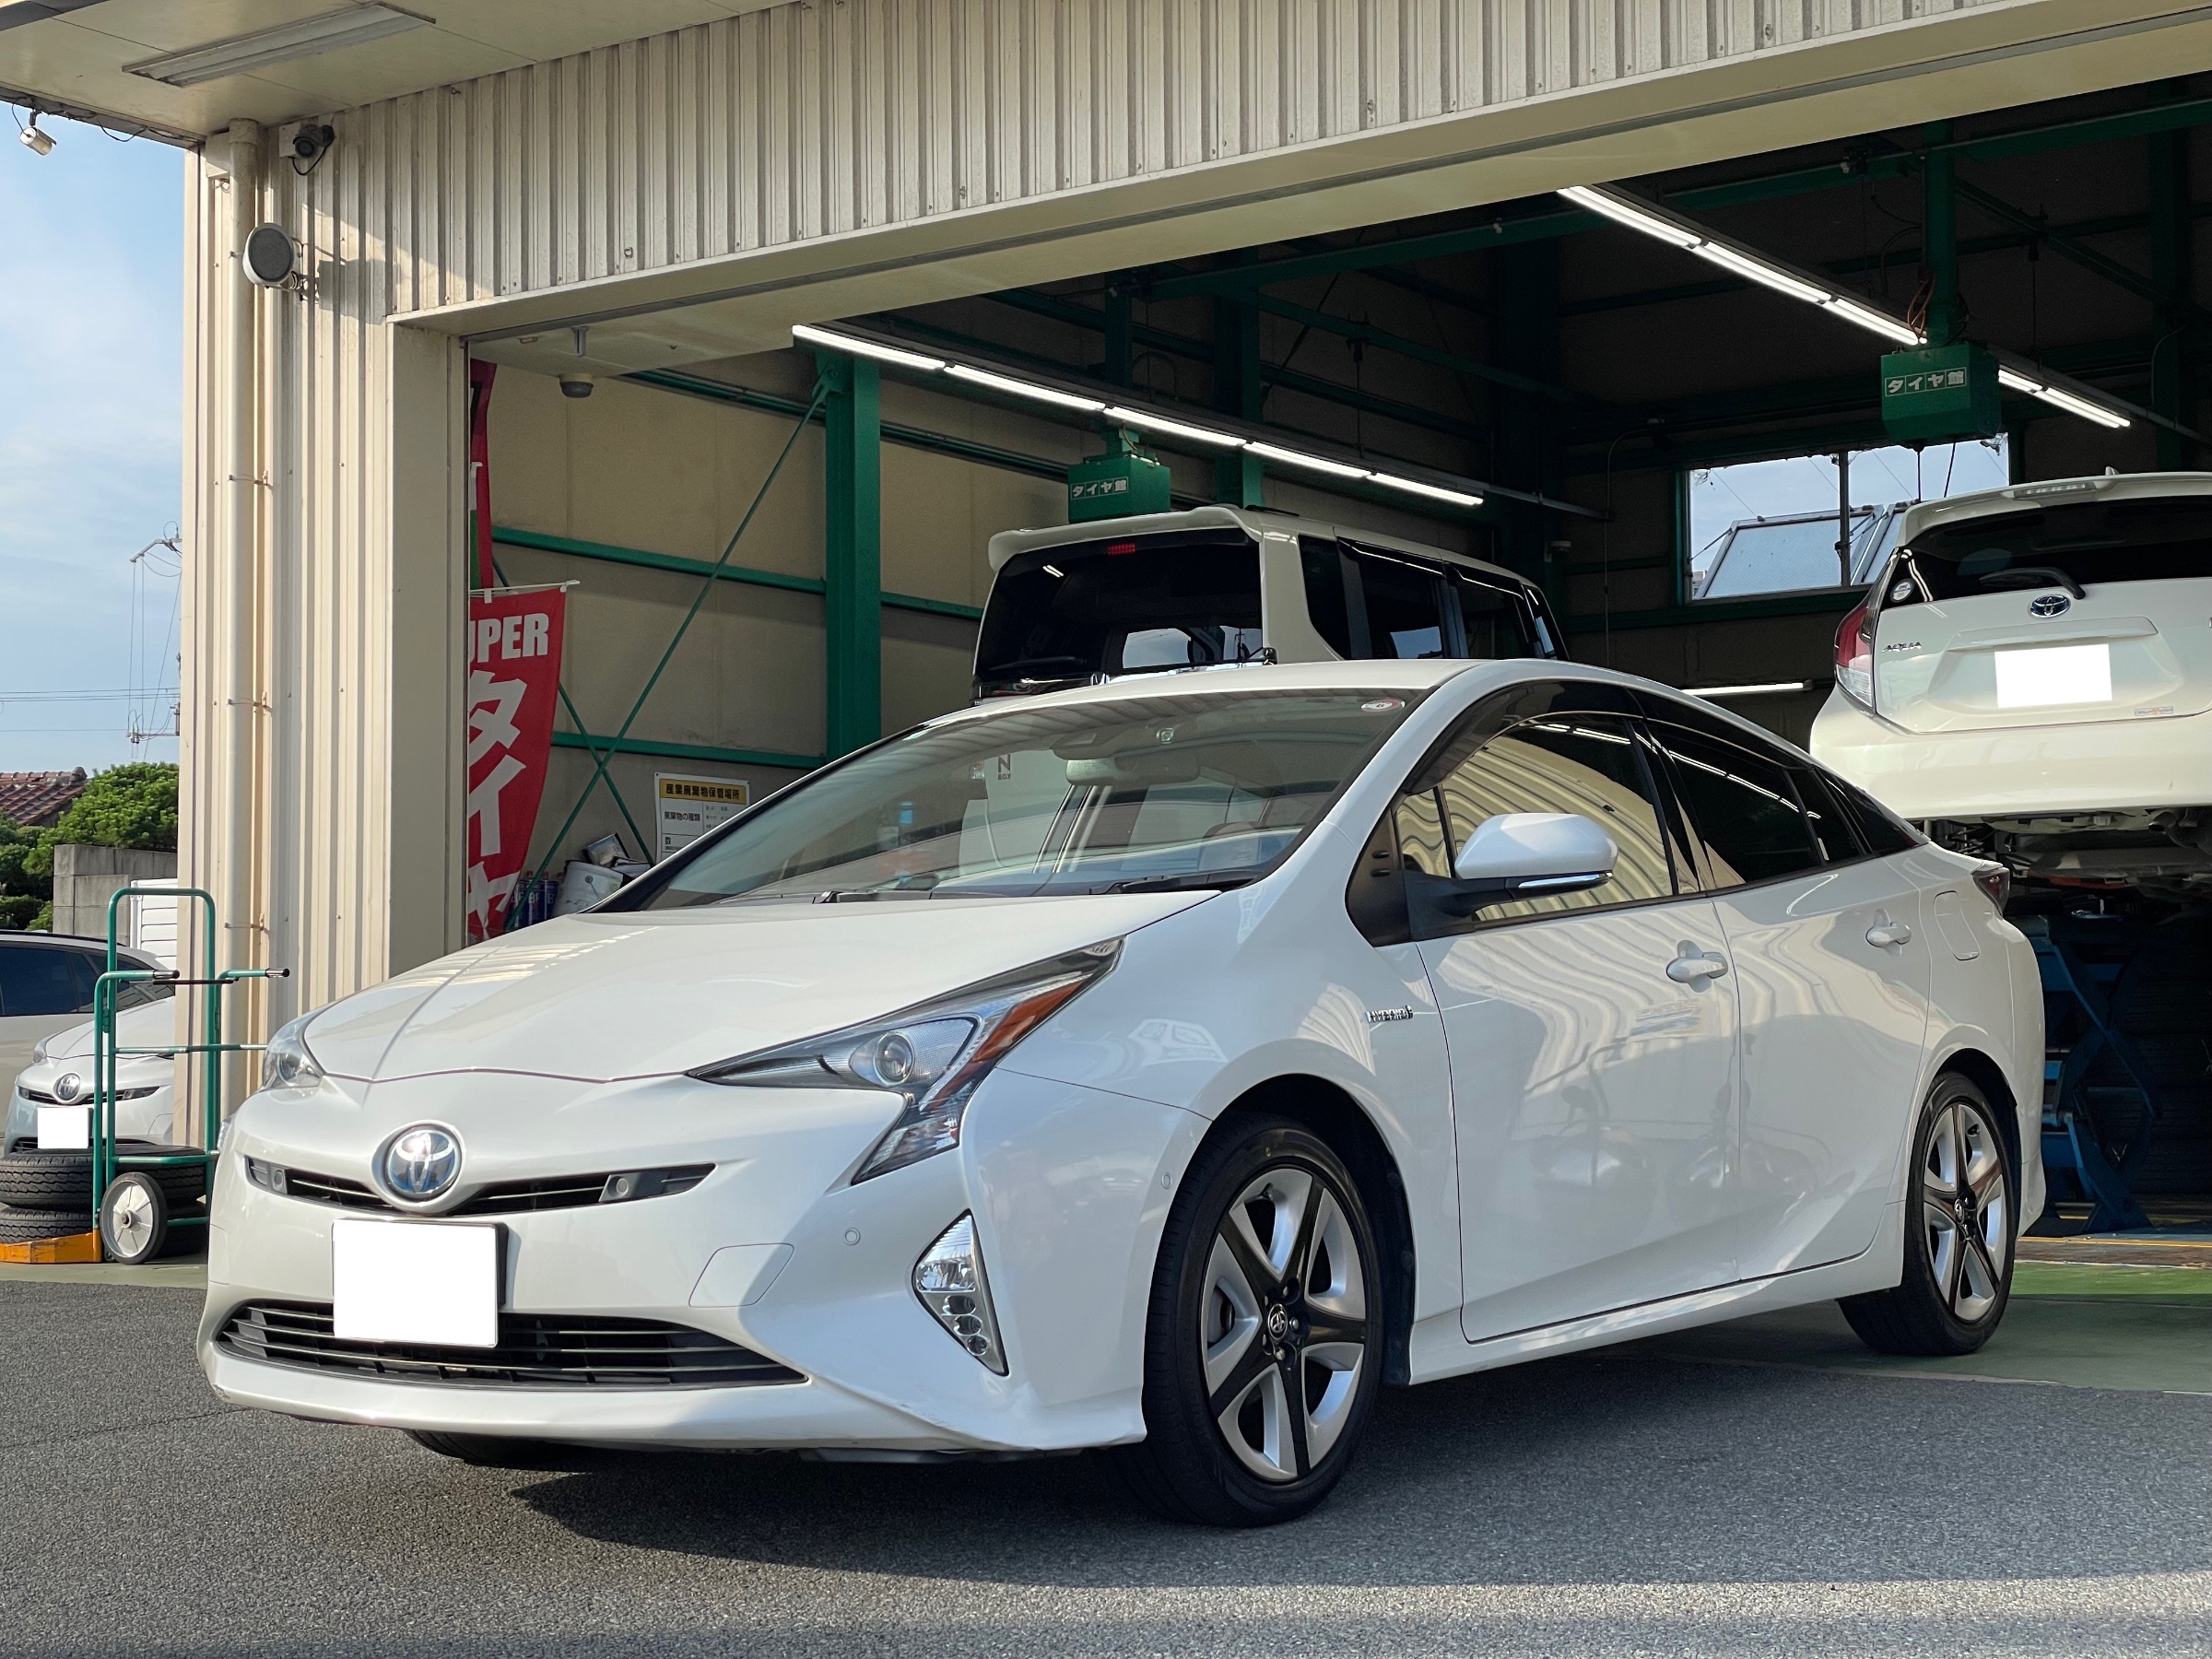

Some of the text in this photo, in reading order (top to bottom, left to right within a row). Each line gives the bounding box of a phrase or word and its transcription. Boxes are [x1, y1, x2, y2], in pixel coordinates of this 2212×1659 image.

[1888, 371, 1965, 394] タイヤ館
[1072, 479, 1127, 498] タイヤ館
[997, 753, 1011, 772] N
[665, 783, 740, 800] 産業廃棄物保管場所
[664, 811, 700, 822] 廃棄物の種類
